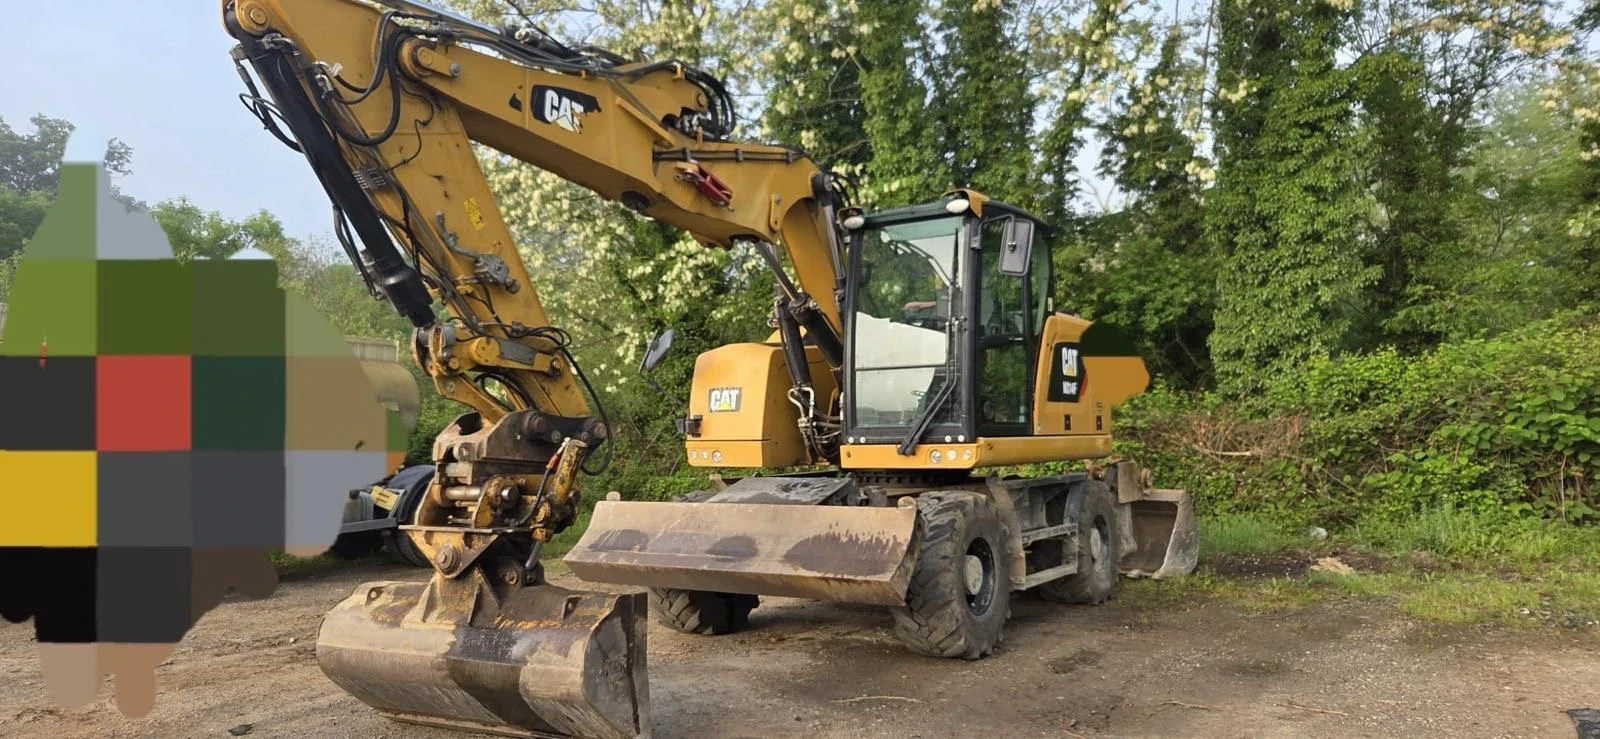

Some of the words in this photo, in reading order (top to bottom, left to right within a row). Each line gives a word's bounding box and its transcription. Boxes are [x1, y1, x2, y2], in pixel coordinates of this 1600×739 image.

[544, 89, 584, 134] CAT
[1061, 347, 1078, 376] CAT
[710, 389, 740, 411] CAT
